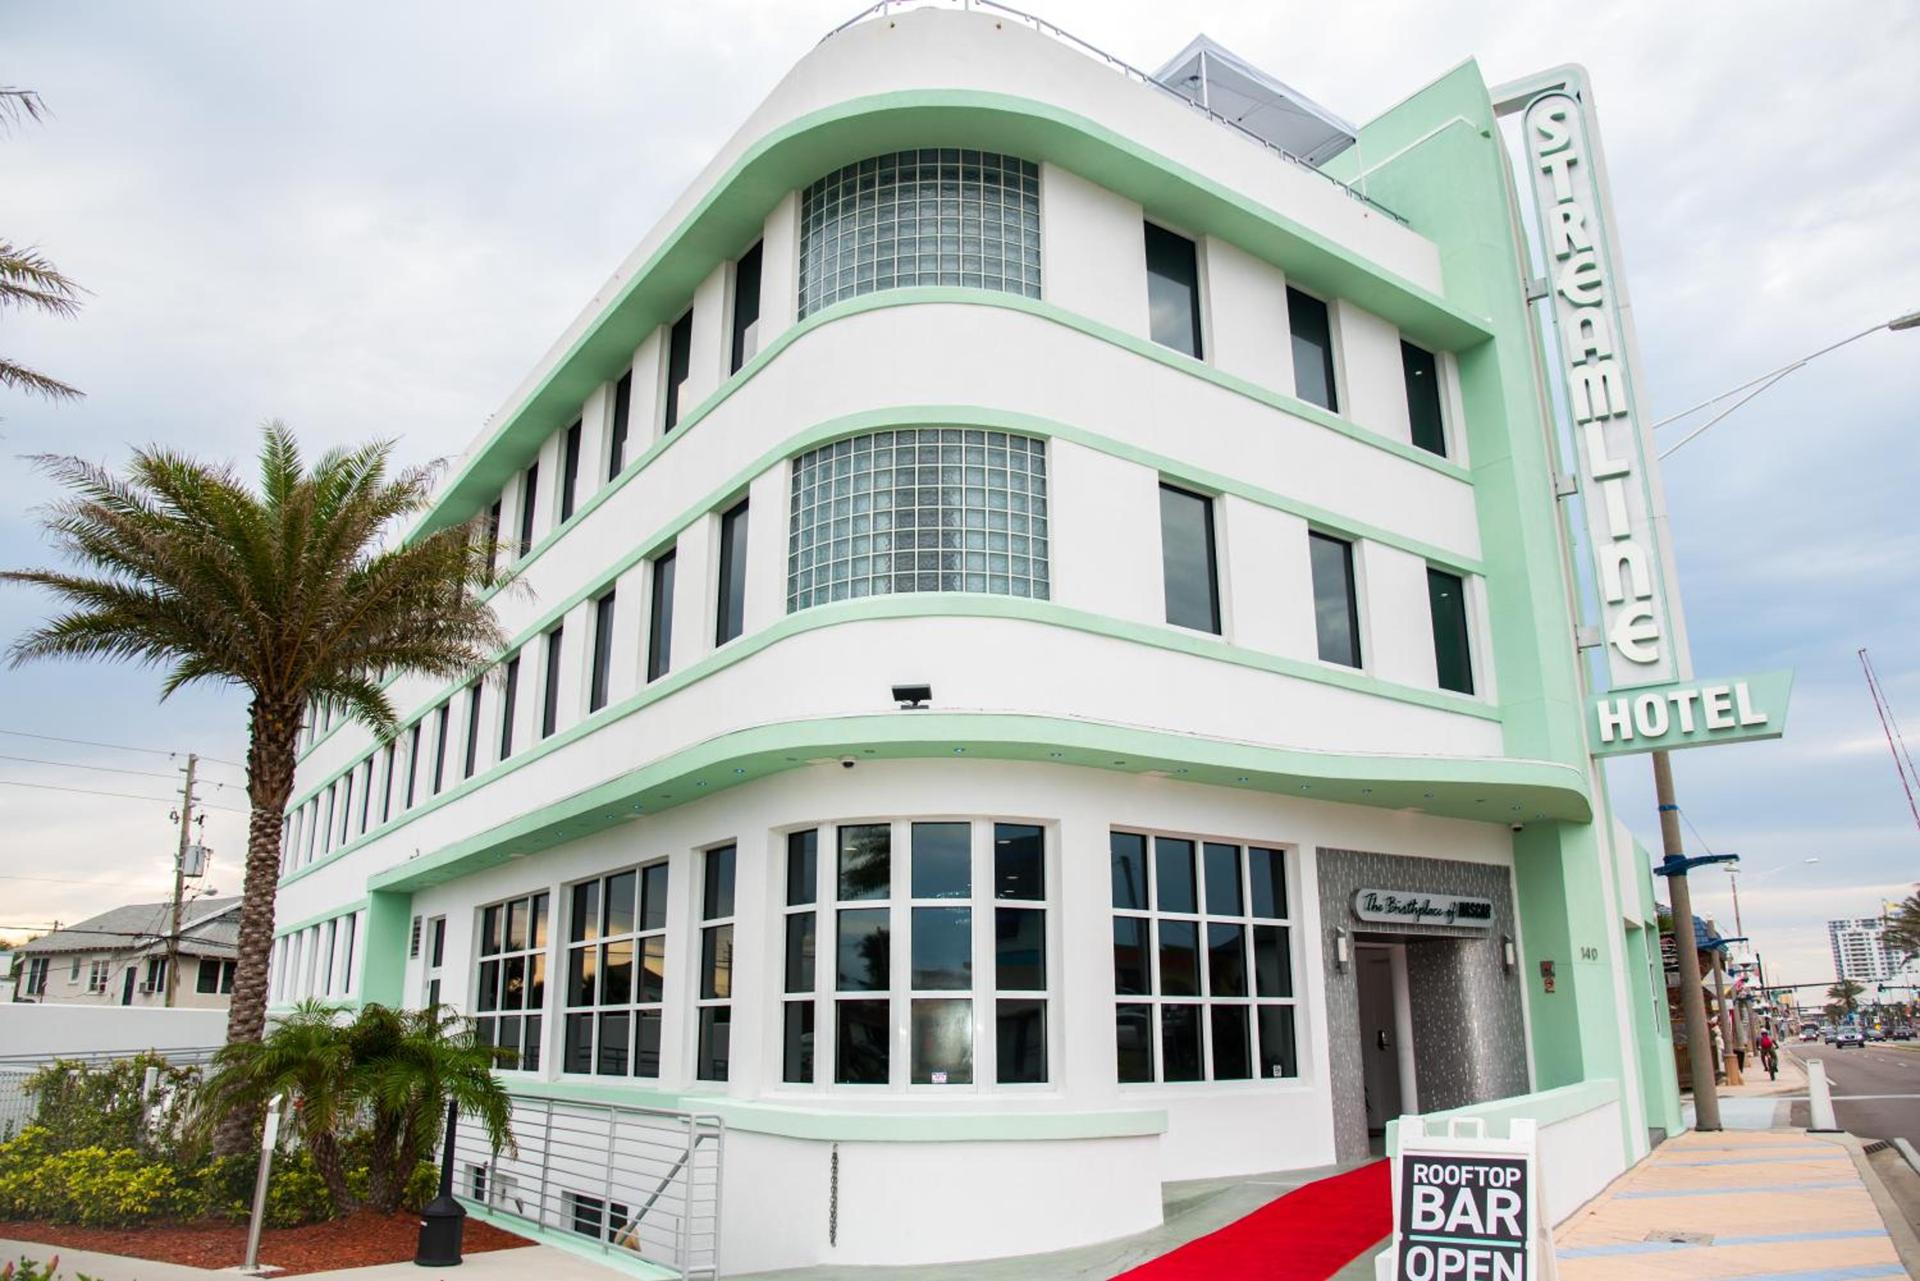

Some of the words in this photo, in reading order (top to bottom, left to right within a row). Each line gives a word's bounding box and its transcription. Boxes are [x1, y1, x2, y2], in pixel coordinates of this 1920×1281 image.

[1596, 682, 1768, 743] HOTEL
[1364, 892, 1384, 912] The
[1385, 896, 1442, 921] Birthplace
[1444, 901, 1456, 924] of
[1580, 946, 1598, 961] 140
[1413, 1163, 1521, 1187] ROOFTOP
[1411, 1185, 1523, 1237] BAR
[1405, 1245, 1523, 1281] OPEN
